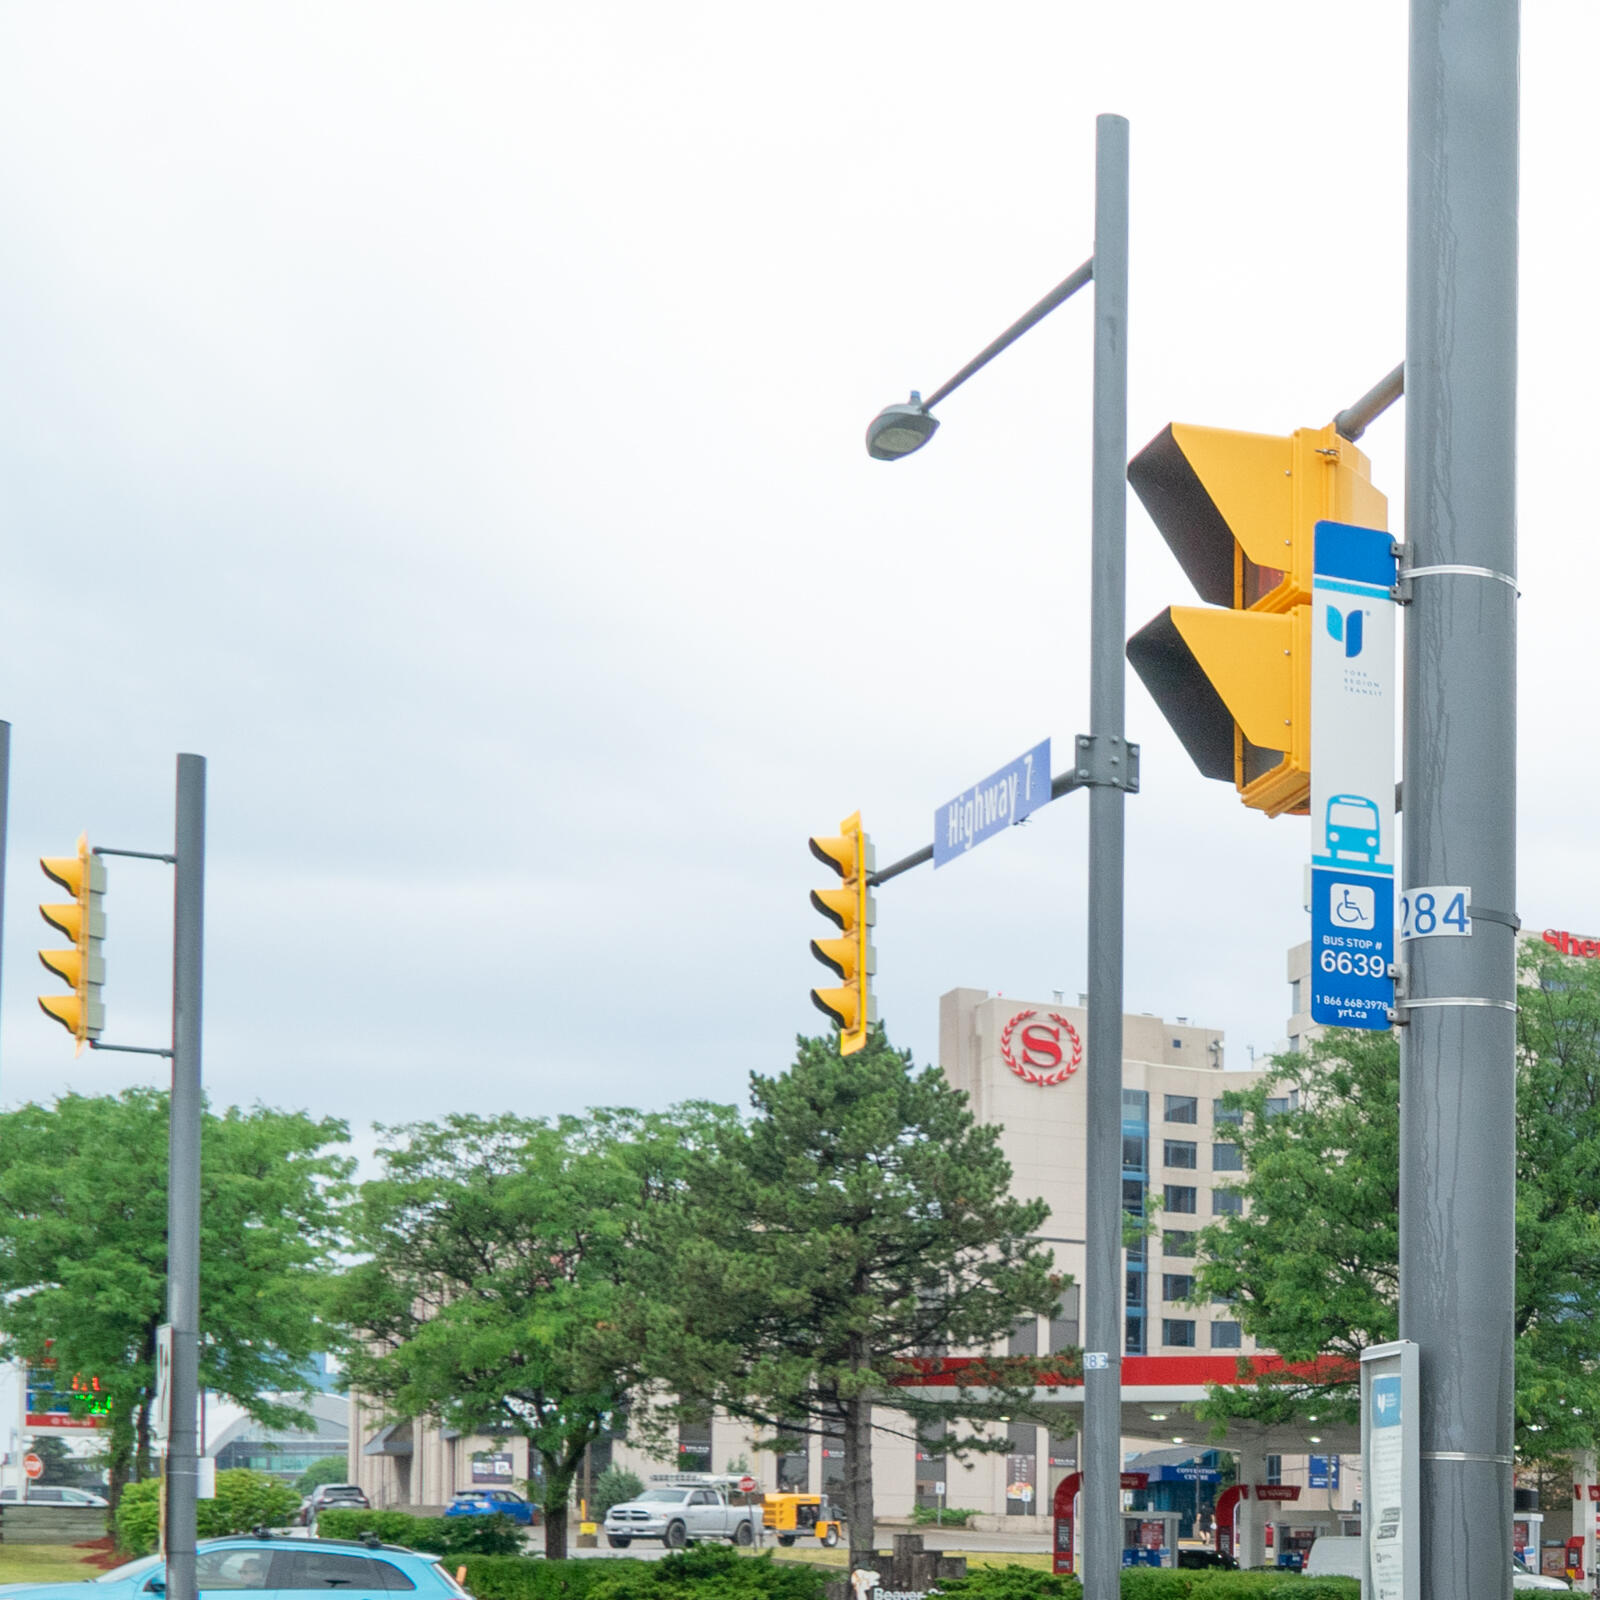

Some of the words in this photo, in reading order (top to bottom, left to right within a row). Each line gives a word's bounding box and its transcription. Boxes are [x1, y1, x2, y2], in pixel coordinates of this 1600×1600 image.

[948, 771, 1018, 851] Highway
[1023, 754, 1033, 801] 7
[1322, 935, 1345, 947] BUS
[1346, 938, 1373, 949] STOP
[1320, 949, 1386, 979] 6639
[1315, 995, 1321, 1004] 1
[1323, 995, 1342, 1006] 866
[1344, 998, 1389, 1011] 668-3978
[1337, 1007, 1368, 1019] yrt.ca
